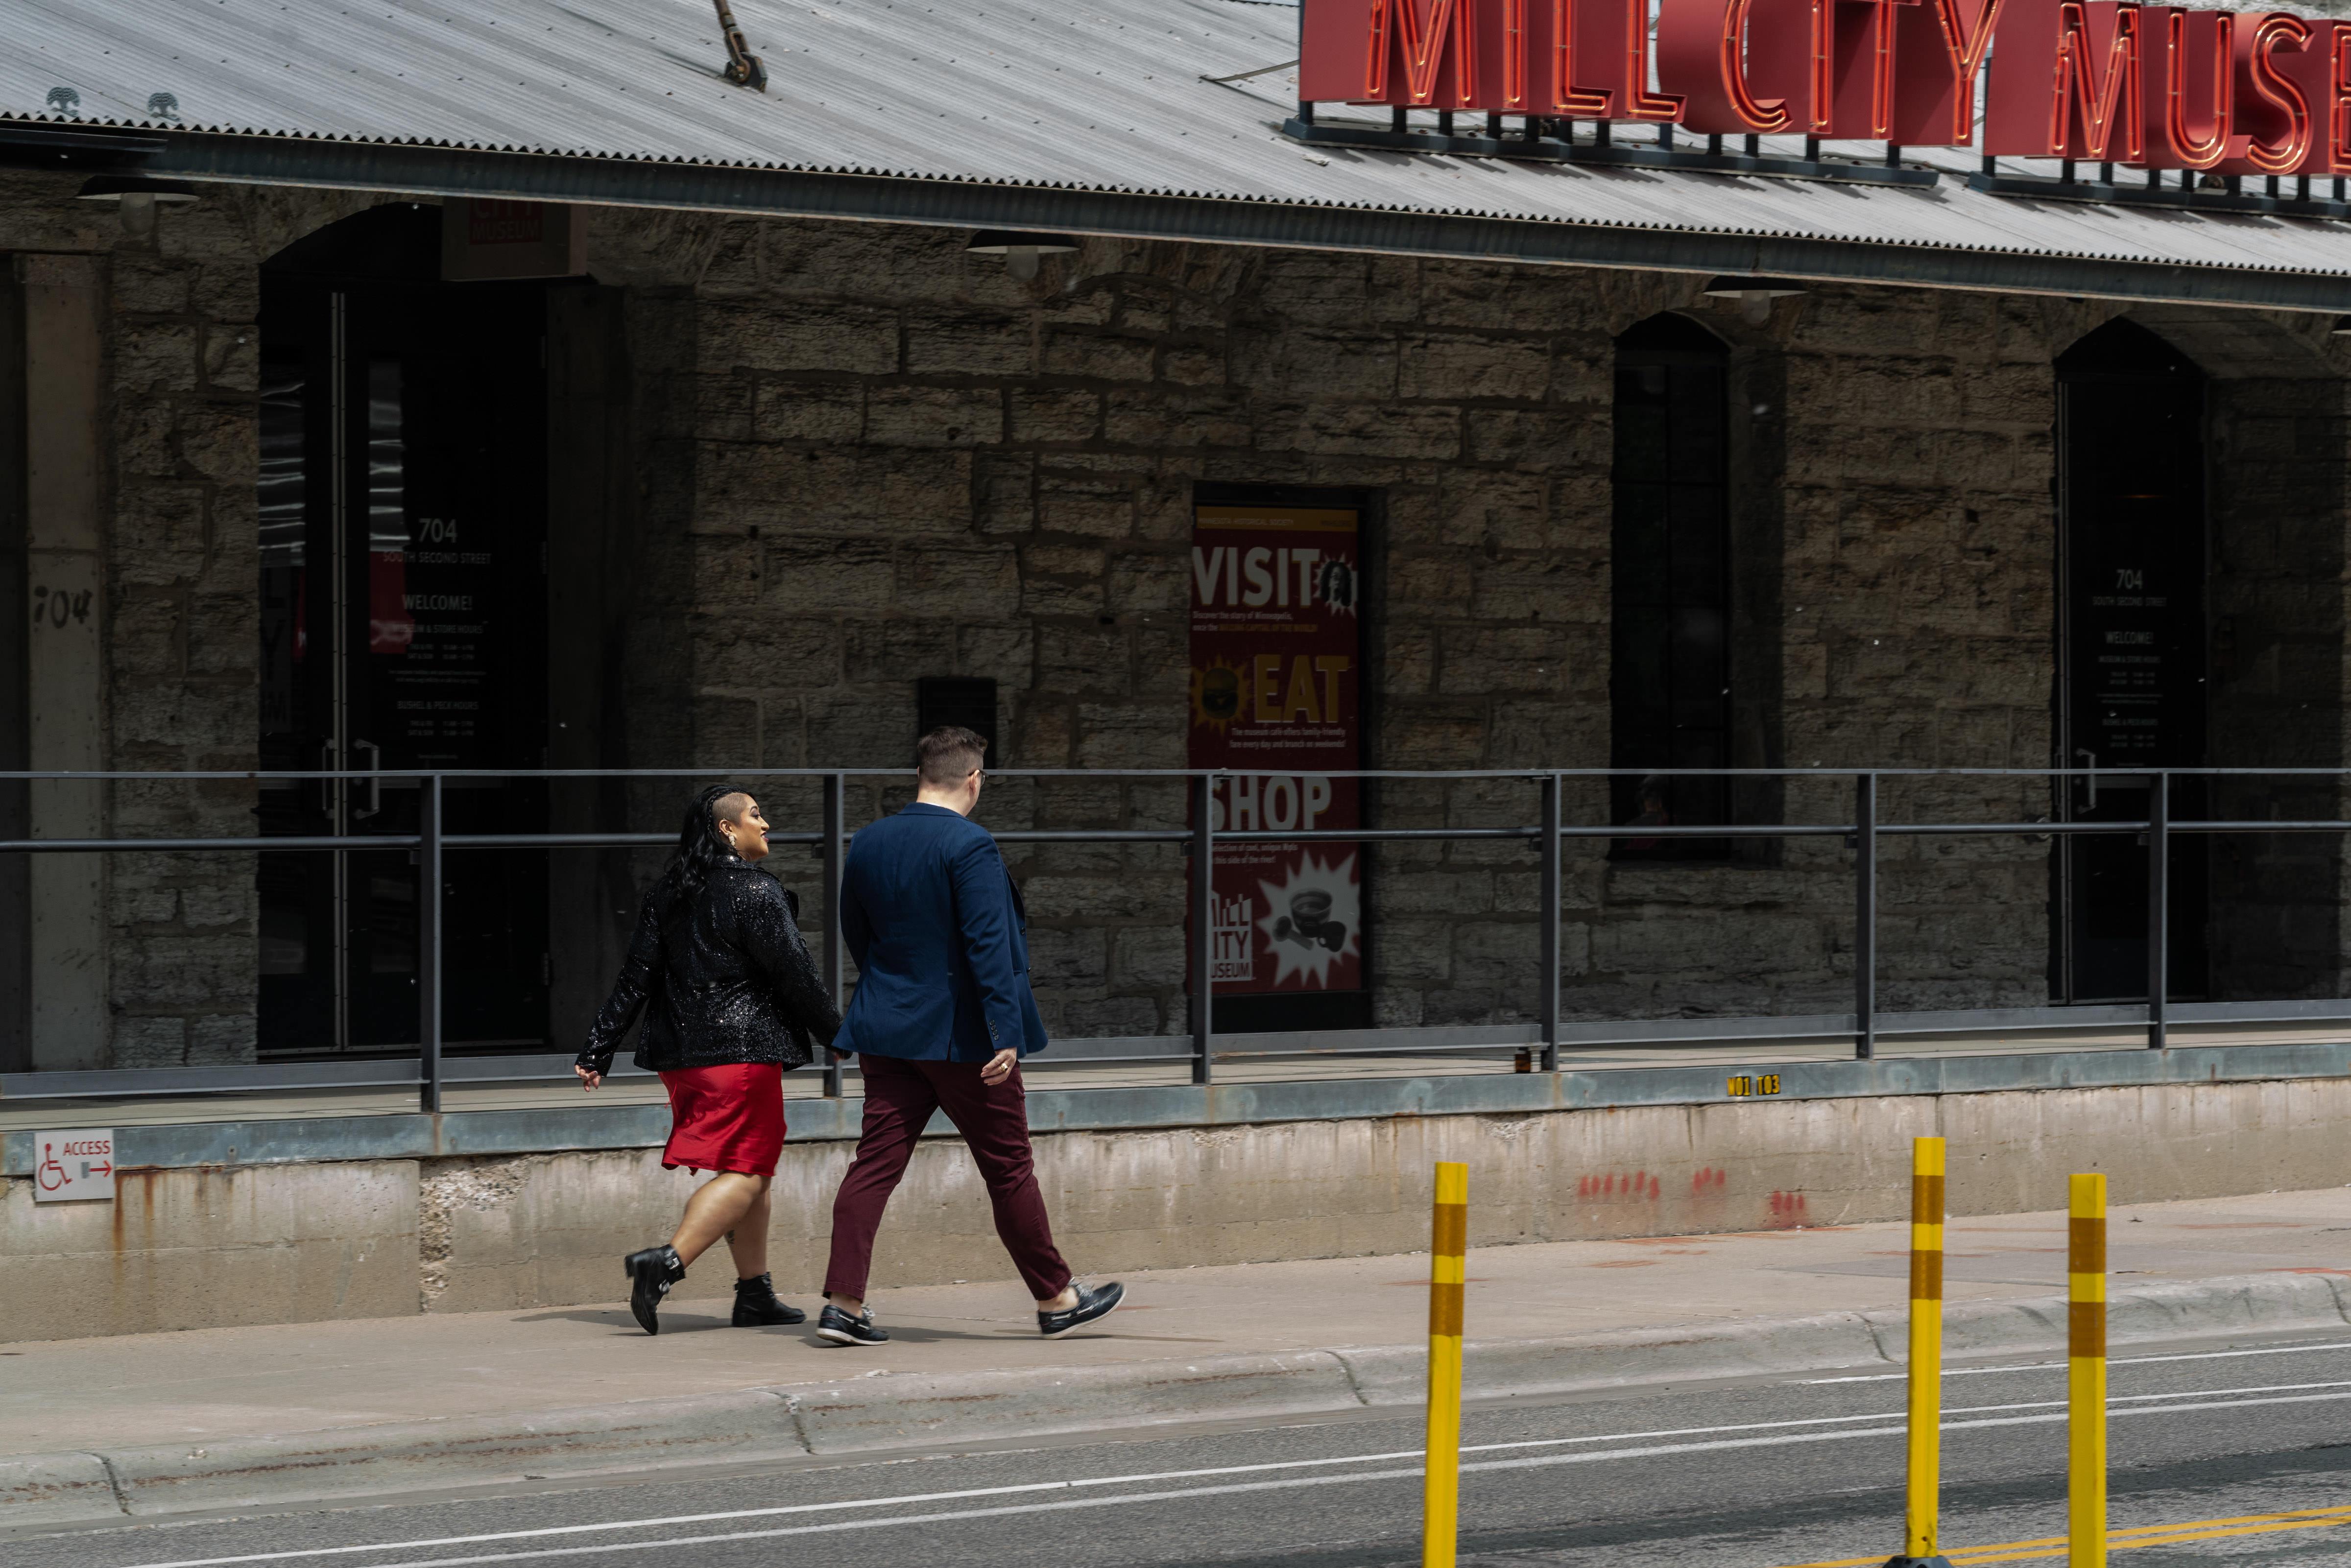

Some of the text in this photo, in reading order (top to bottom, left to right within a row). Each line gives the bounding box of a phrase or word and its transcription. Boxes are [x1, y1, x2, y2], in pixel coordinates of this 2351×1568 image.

[1364, 0, 1687, 123] MILL
[1719, 0, 2004, 147] CITY
[473, 220, 539, 240] MUSEUM
[418, 518, 458, 544] 704
[383, 551, 493, 564] SOUTH SECOND STREET
[1192, 546, 1321, 608] VISIT
[2116, 569, 2143, 590] 704
[402, 594, 473, 611] WELCOME!
[1192, 611, 1218, 619] Discover
[1254, 654, 1349, 723] EAT
[1213, 844, 1237, 852] election
[1214, 930, 1248, 960] ITY
[1211, 963, 1251, 978] USEUM
[63, 1140, 111, 1156] ACCESS
